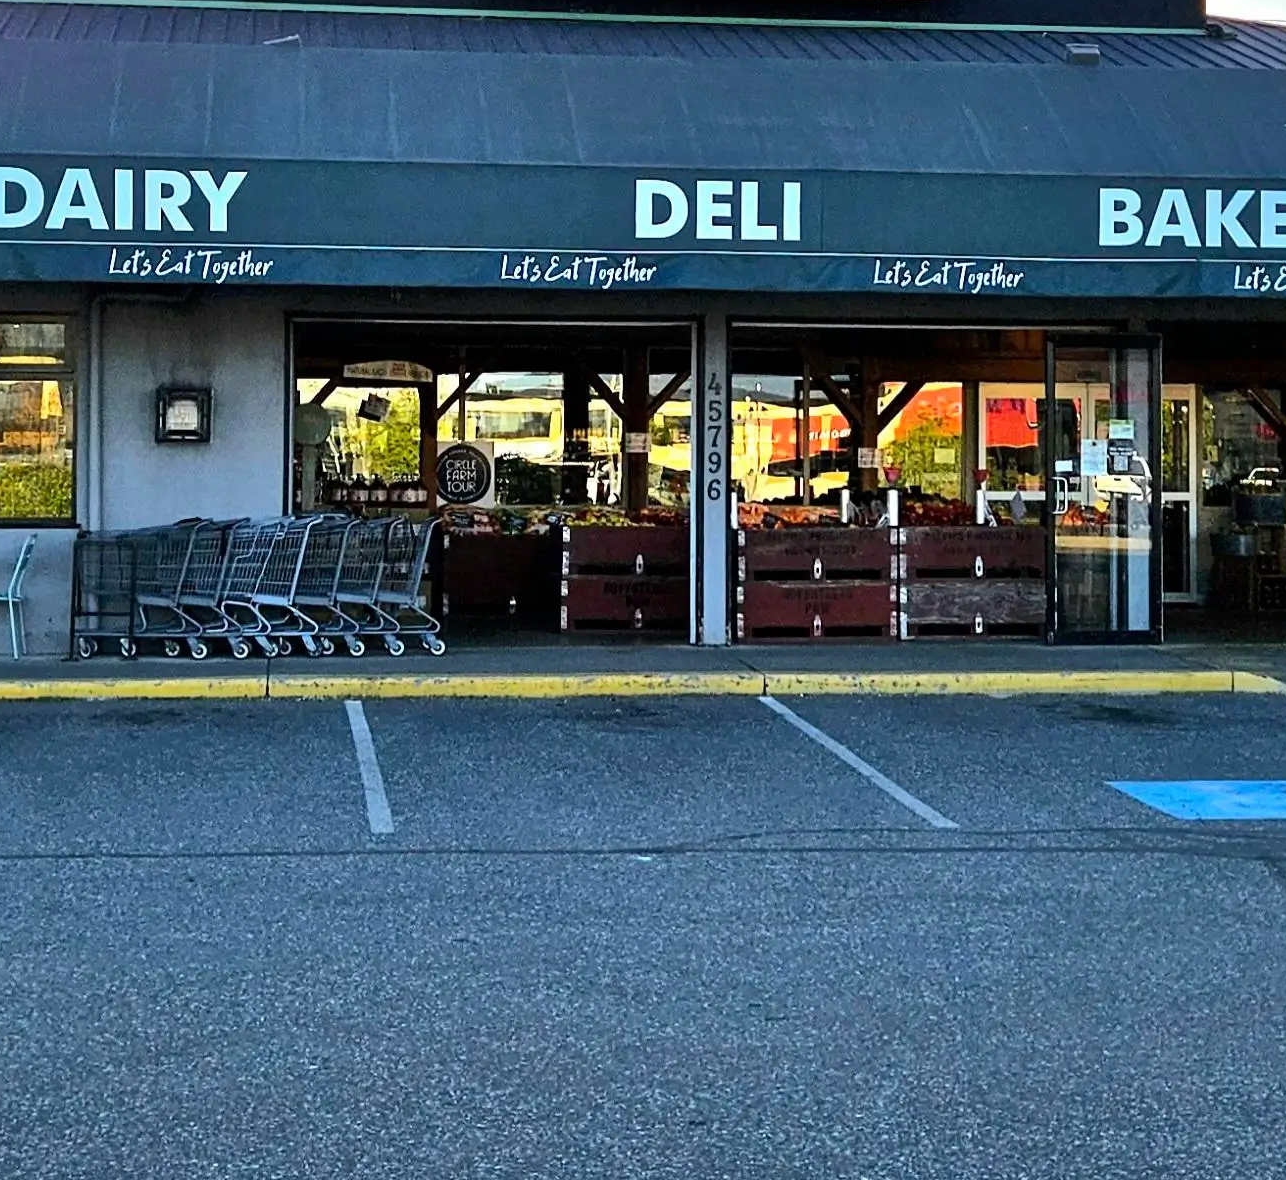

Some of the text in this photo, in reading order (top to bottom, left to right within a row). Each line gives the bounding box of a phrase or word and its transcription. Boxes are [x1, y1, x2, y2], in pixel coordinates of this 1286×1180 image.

[634, 179, 802, 242] DELI
[109, 248, 274, 284] Let's Eat Together
[501, 254, 657, 289] Let's Eat Together
[873, 259, 1024, 294] Let's Eat Together
[1234, 265, 1272, 292] Let's
[707, 372, 723, 501] 45796
[445, 459, 477, 470] CIRCLE
[446, 470, 477, 481] FARM
[446, 481, 477, 493] TOUR
